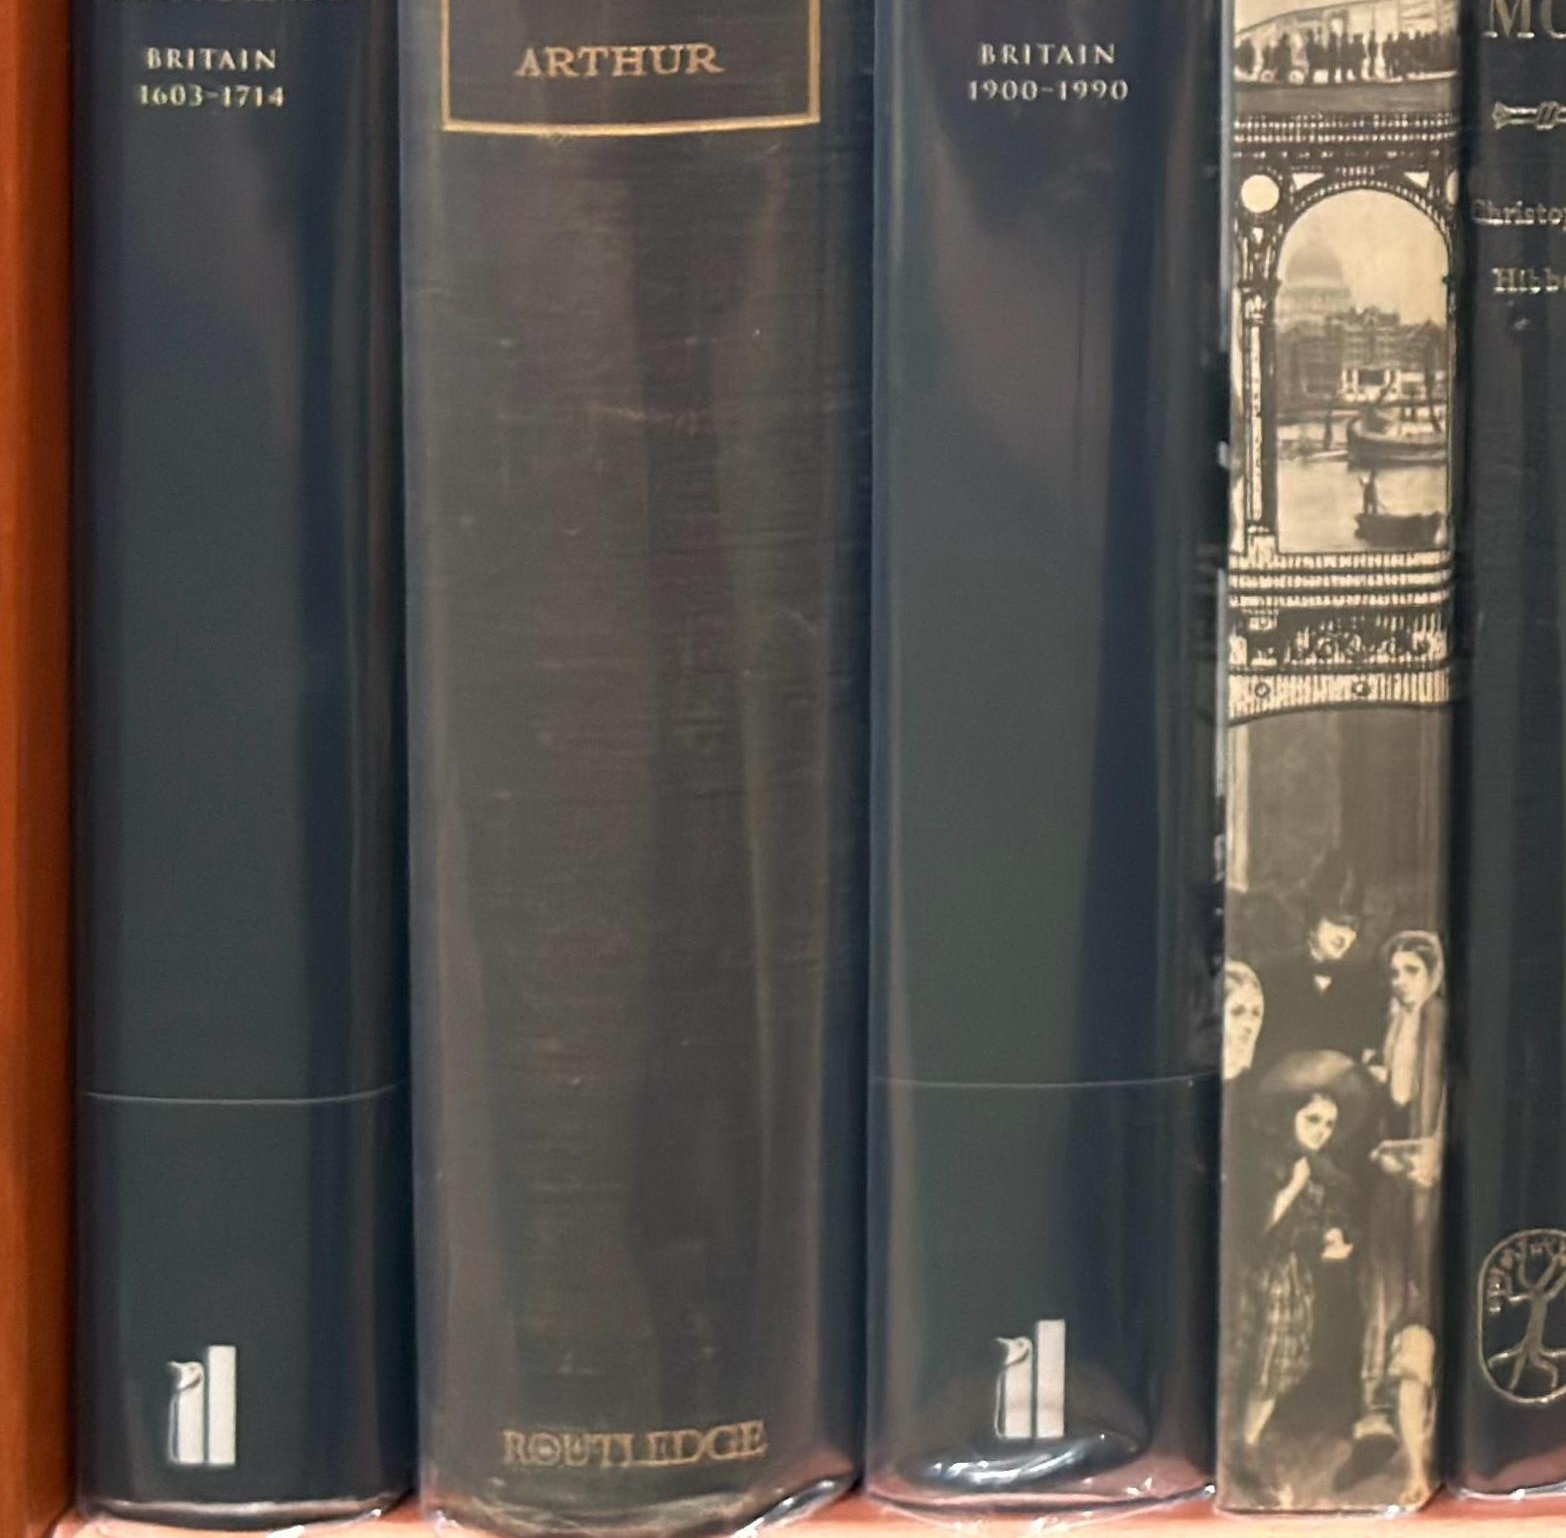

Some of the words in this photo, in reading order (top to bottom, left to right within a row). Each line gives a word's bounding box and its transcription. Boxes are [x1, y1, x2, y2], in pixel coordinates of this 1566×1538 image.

[147, 49, 277, 70] BRITAIN
[515, 43, 724, 79] ARTHUR
[977, 44, 1116, 66] BRITAIN
[503, 1420, 768, 1469] ROUTLEDGE
